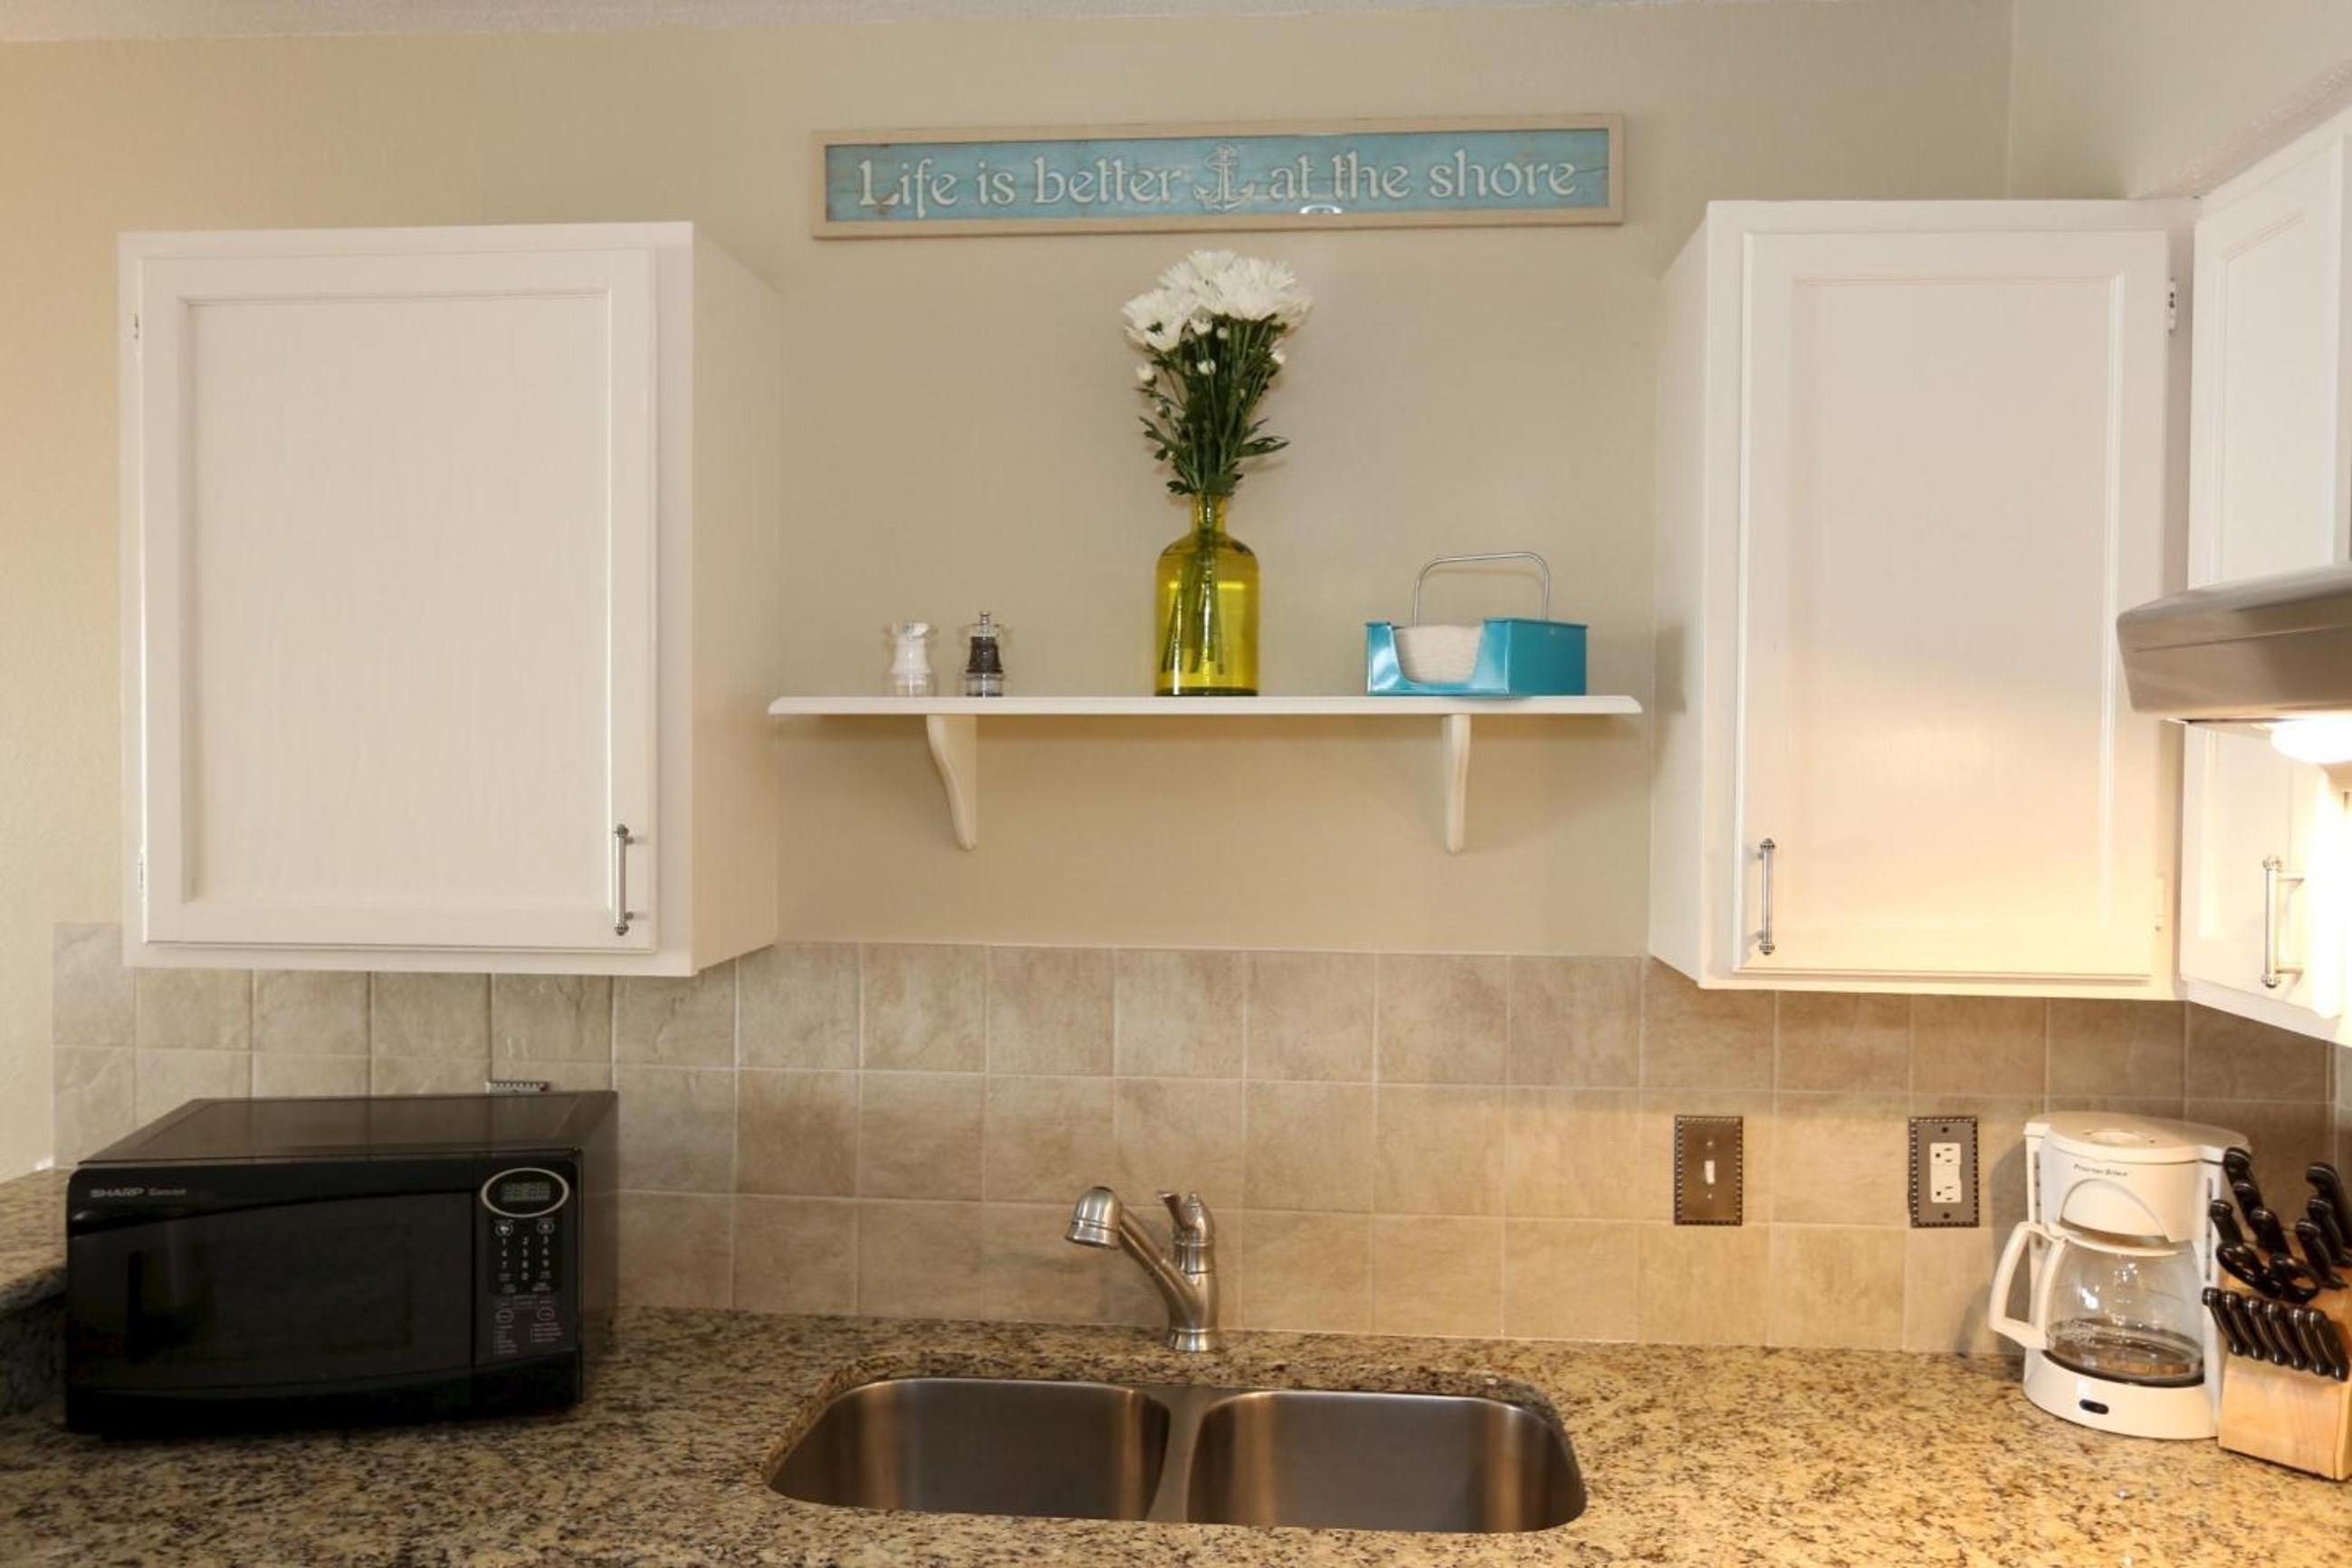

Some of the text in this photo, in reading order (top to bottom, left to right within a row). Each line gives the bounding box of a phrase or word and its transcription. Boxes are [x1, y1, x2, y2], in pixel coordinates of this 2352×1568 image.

[857, 148, 1576, 219] Life is better at the shore
[89, 1187, 145, 1199] SHARP
